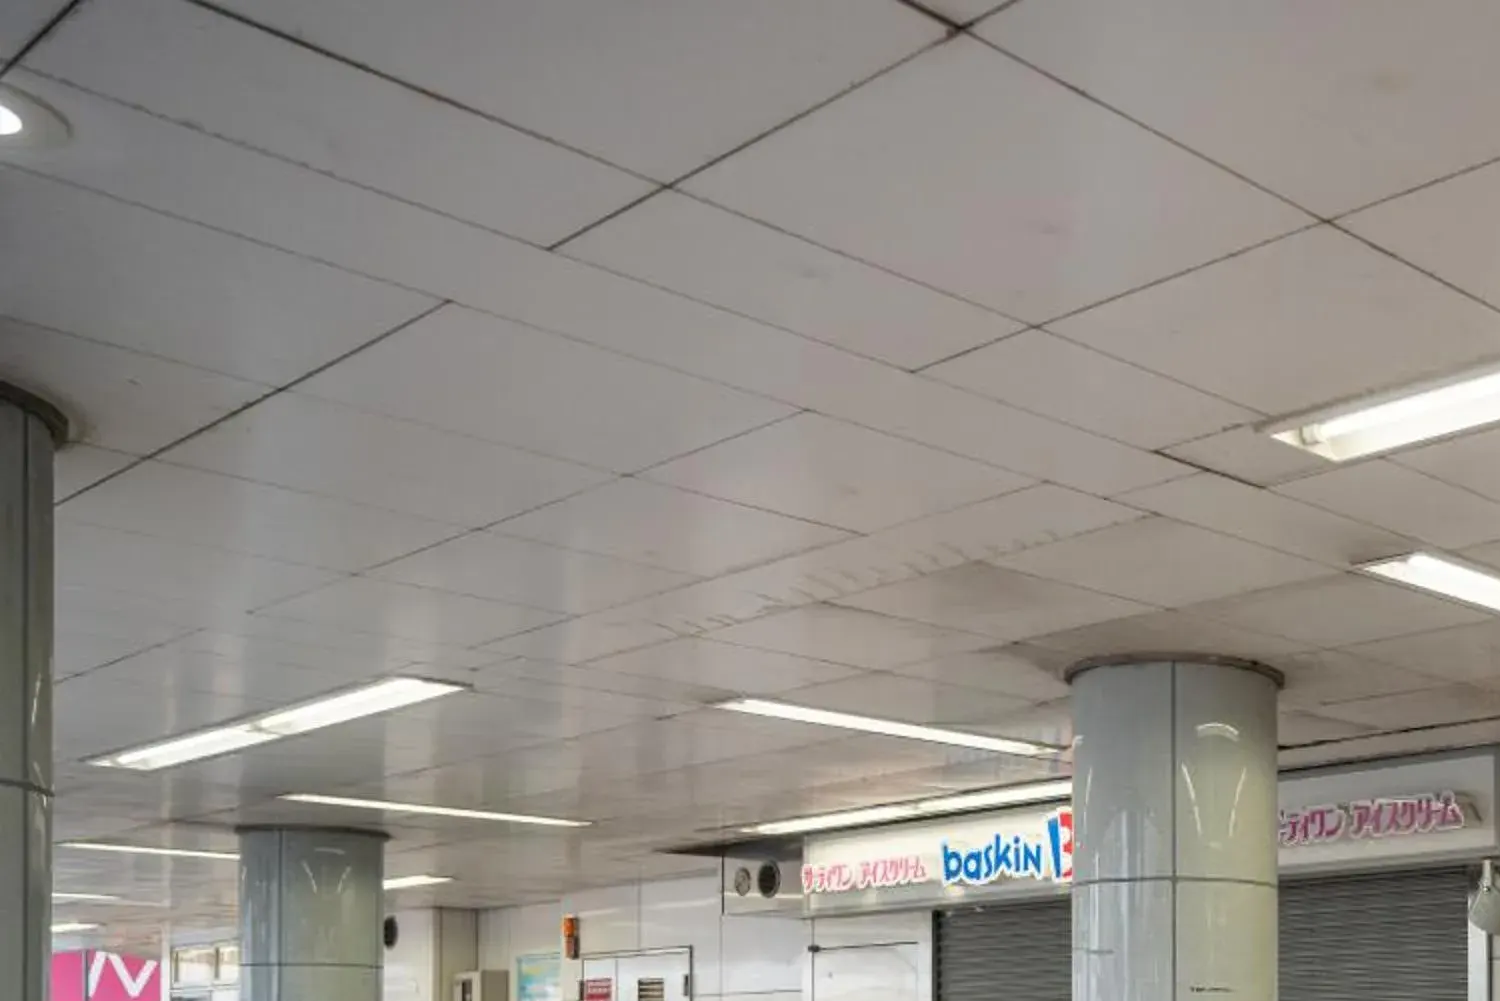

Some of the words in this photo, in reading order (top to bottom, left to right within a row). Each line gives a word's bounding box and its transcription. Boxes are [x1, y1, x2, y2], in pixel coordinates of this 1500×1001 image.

[1352, 791, 1463, 835] アイスクリーム
[859, 856, 927, 889] アイスクリーム
